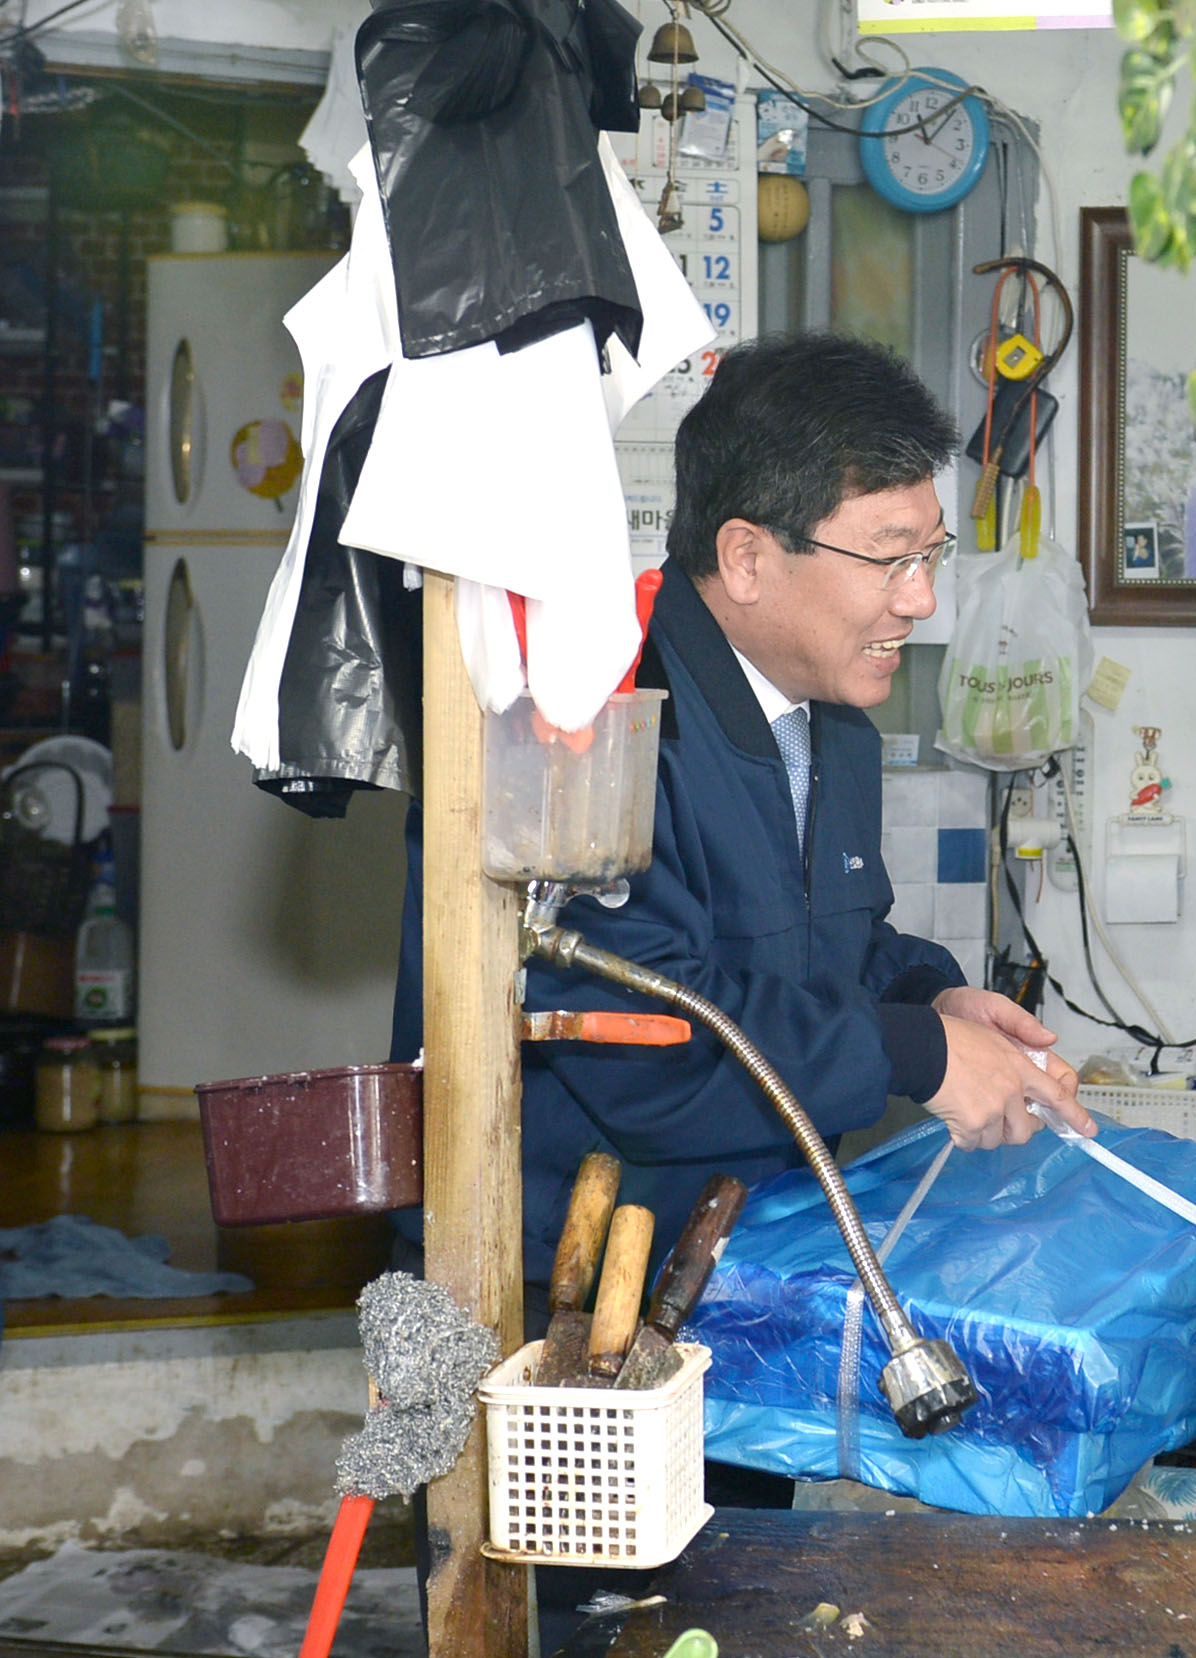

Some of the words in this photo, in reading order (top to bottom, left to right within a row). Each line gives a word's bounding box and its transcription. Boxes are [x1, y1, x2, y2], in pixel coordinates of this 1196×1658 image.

[910, 101, 919, 112] 11
[926, 97, 939, 109] 12
[897, 113, 910, 124] 10
[955, 138, 965, 151] 3
[891, 151, 900, 163] 8
[903, 165, 912, 177] 7
[935, 169, 945, 181] 5
[918, 173, 928, 185] 6
[706, 181, 728, 194] 土
[709, 208, 724, 232] 5
[703, 255, 730, 280] 12
[703, 303, 731, 327] 19
[960, 674, 996, 694] TOUS
[1006, 670, 1054, 693] JOURS
